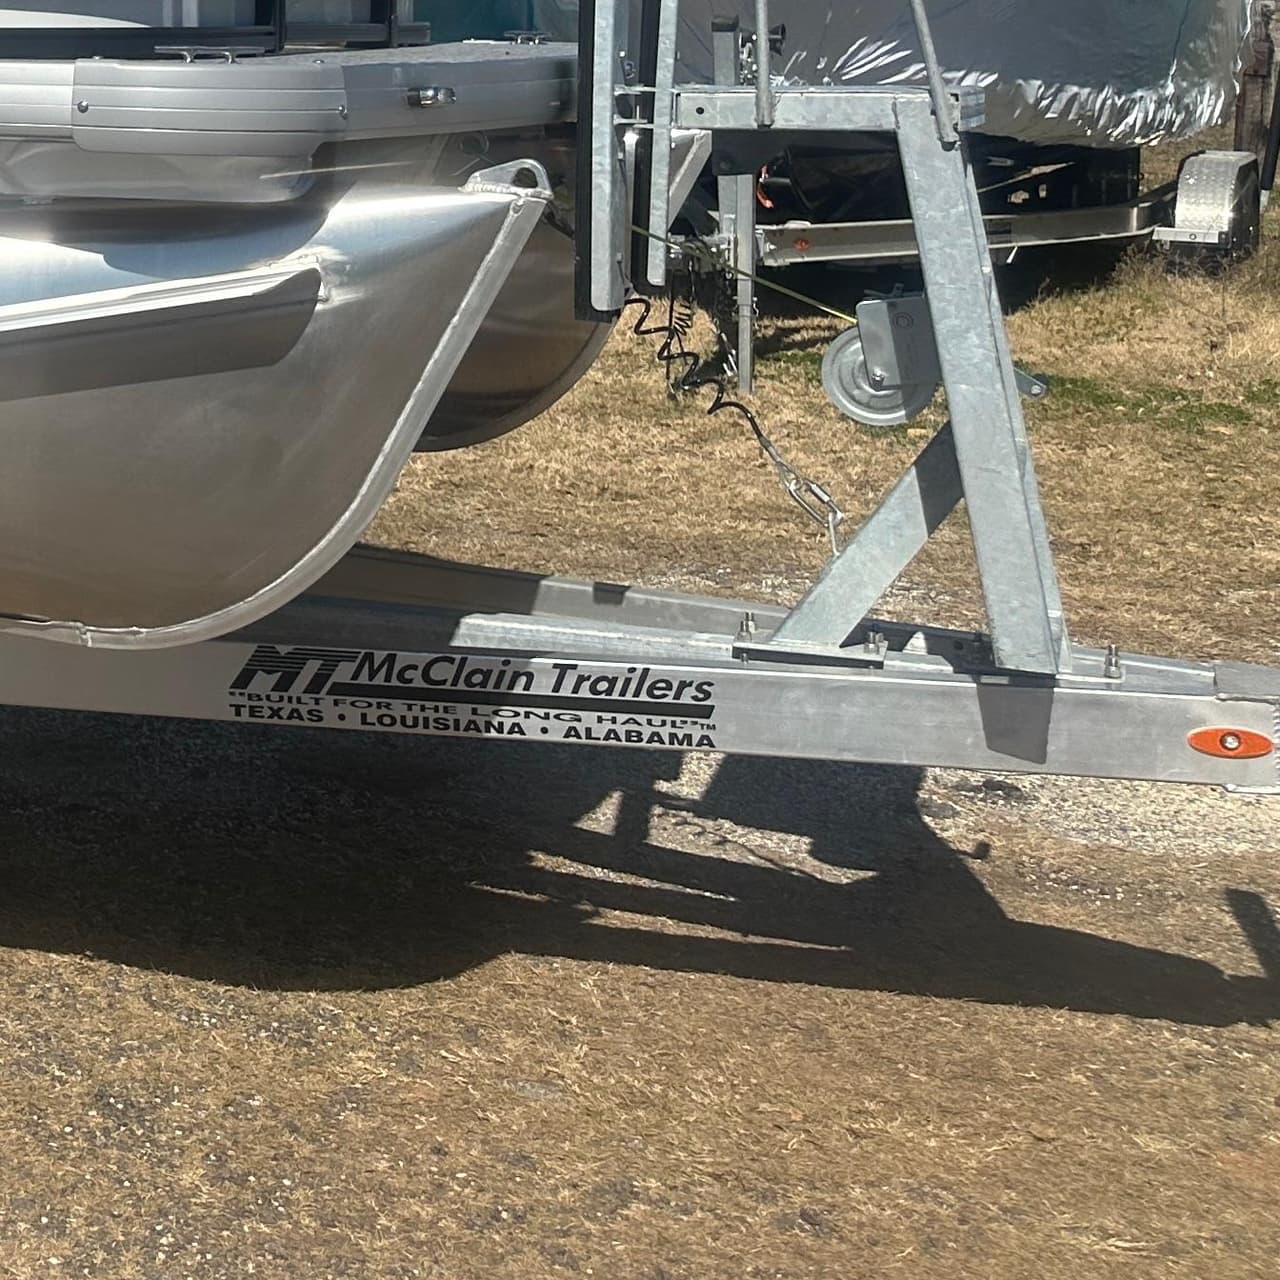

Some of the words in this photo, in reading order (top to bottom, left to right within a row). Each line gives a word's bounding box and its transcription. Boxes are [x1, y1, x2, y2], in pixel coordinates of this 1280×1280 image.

[350, 651, 535, 693] McClain
[551, 663, 716, 702] Trailers
[228, 704, 325, 723] TEXAS
[360, 712, 527, 736] LOUISIANA
[563, 726, 717, 749] ALABAMA
[333, 698, 394, 711] FOR
[401, 702, 458, 714] THE
[471, 707, 583, 723] LONG
